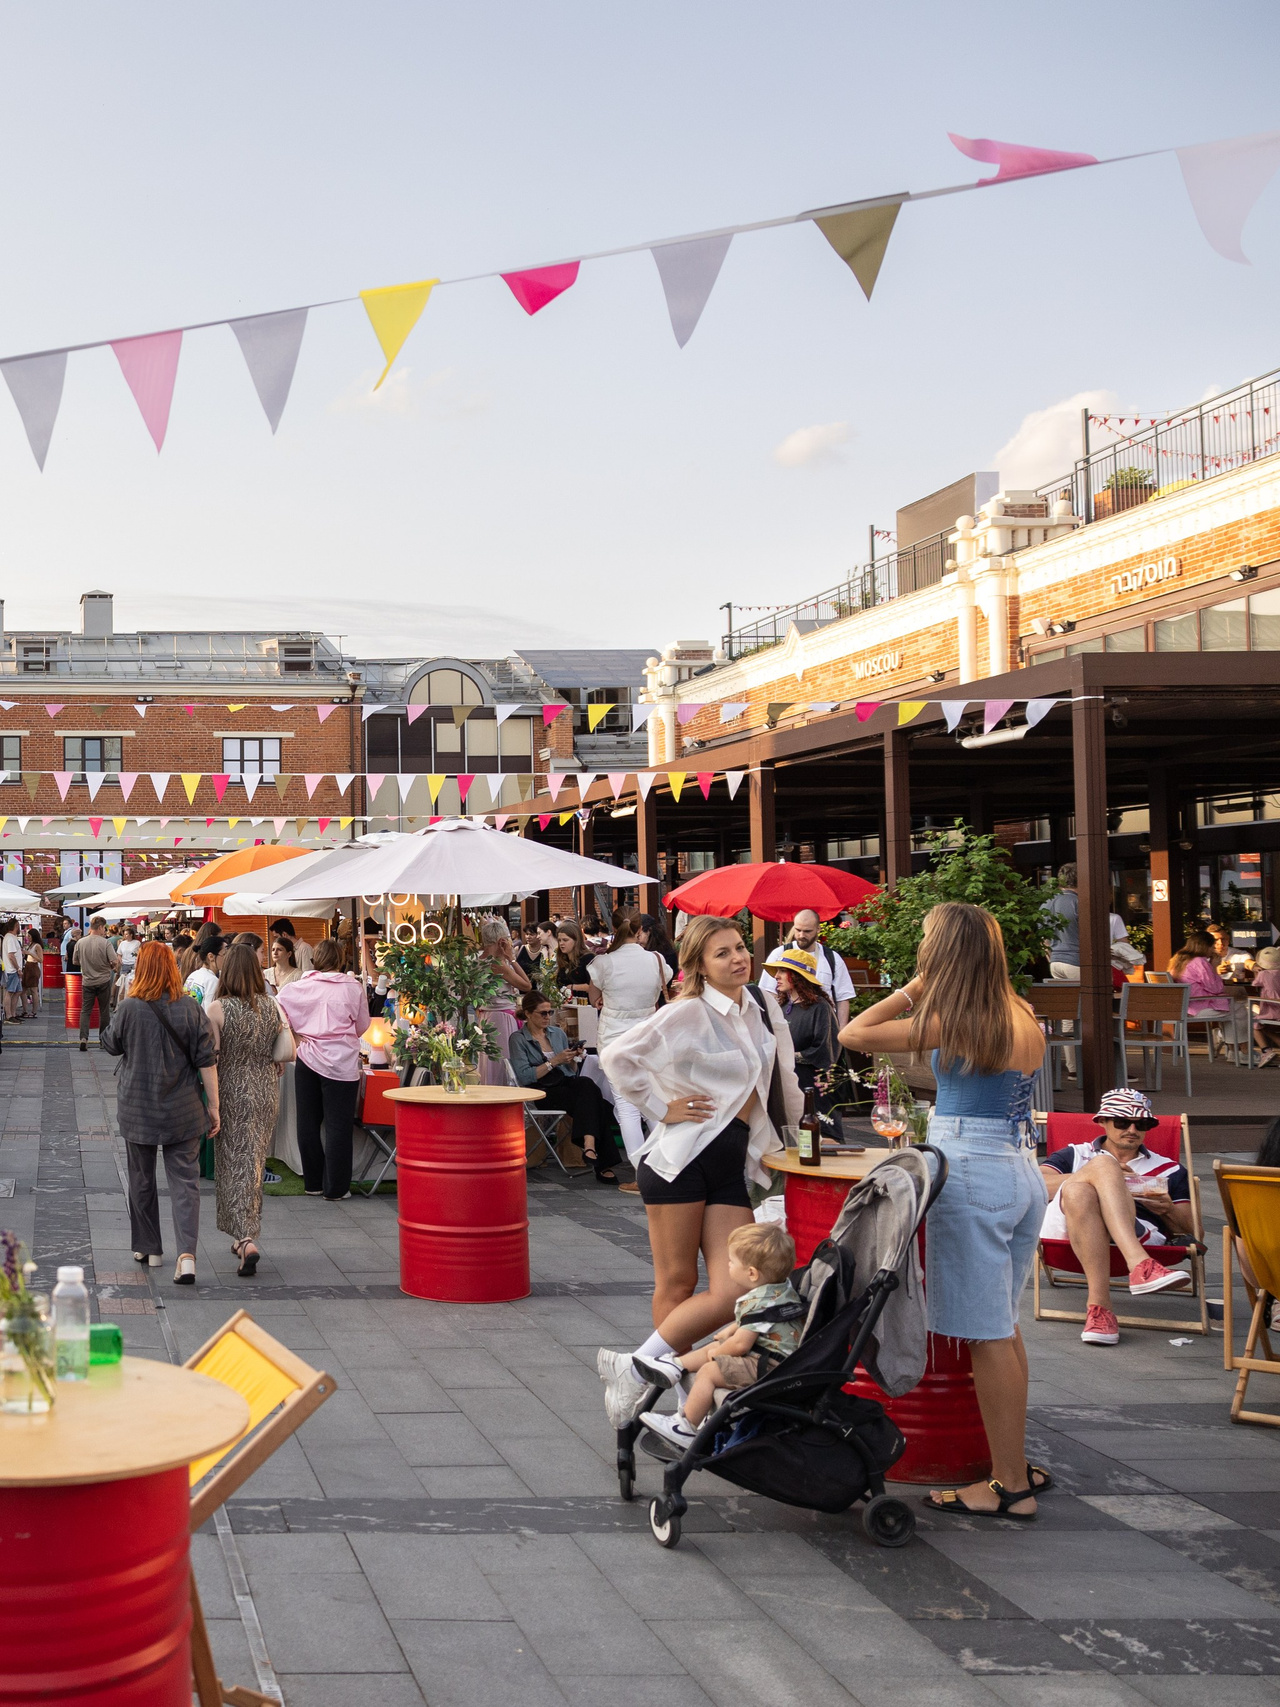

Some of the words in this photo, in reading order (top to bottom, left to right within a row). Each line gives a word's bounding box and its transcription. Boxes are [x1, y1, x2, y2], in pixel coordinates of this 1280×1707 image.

[1110, 556, 1177, 595] מוסקבה
[855, 651, 899, 681] MOSCOU
[386, 911, 444, 945] lab
